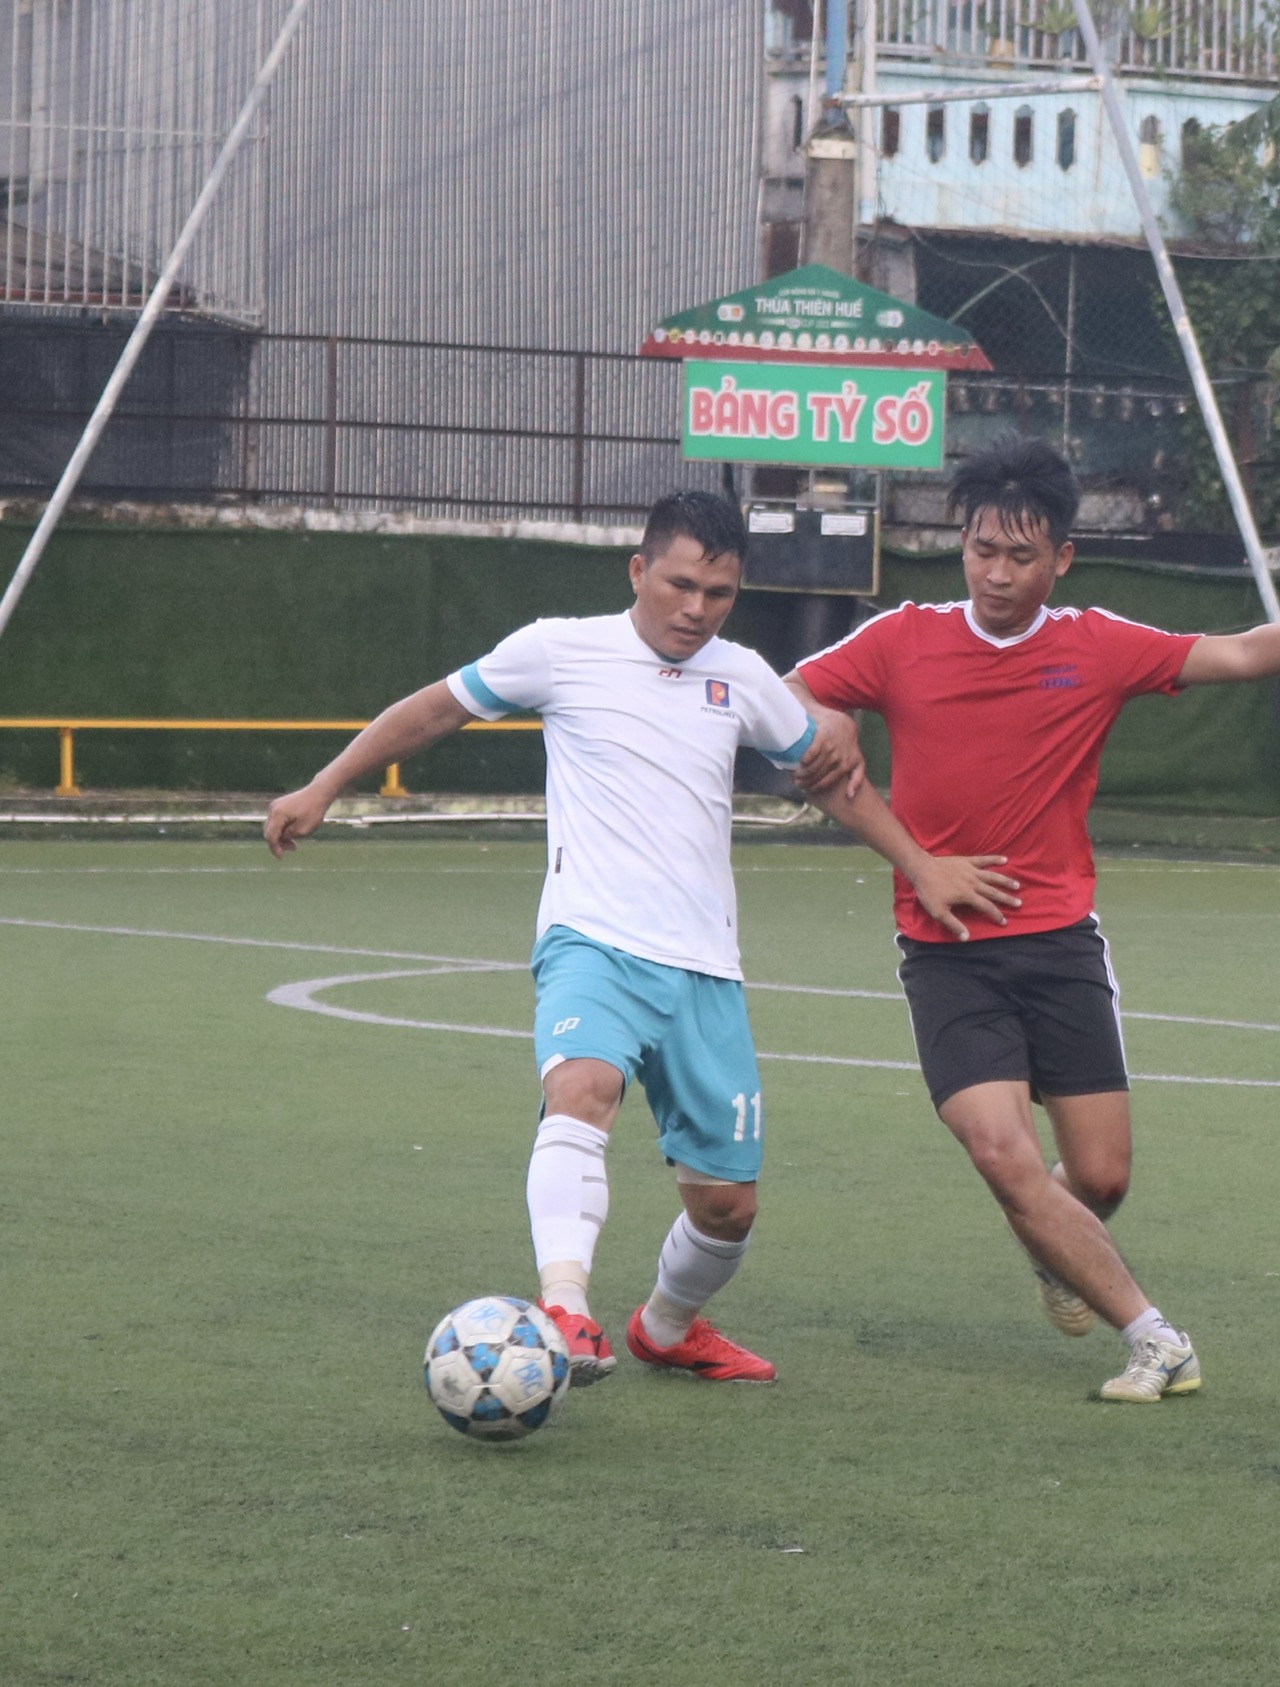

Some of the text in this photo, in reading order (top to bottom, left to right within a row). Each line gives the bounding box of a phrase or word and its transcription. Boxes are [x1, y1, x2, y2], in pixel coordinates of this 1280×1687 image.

[690, 375, 933, 446] BẢNG TỶ SỐ
[731, 1090, 764, 1142] 11
